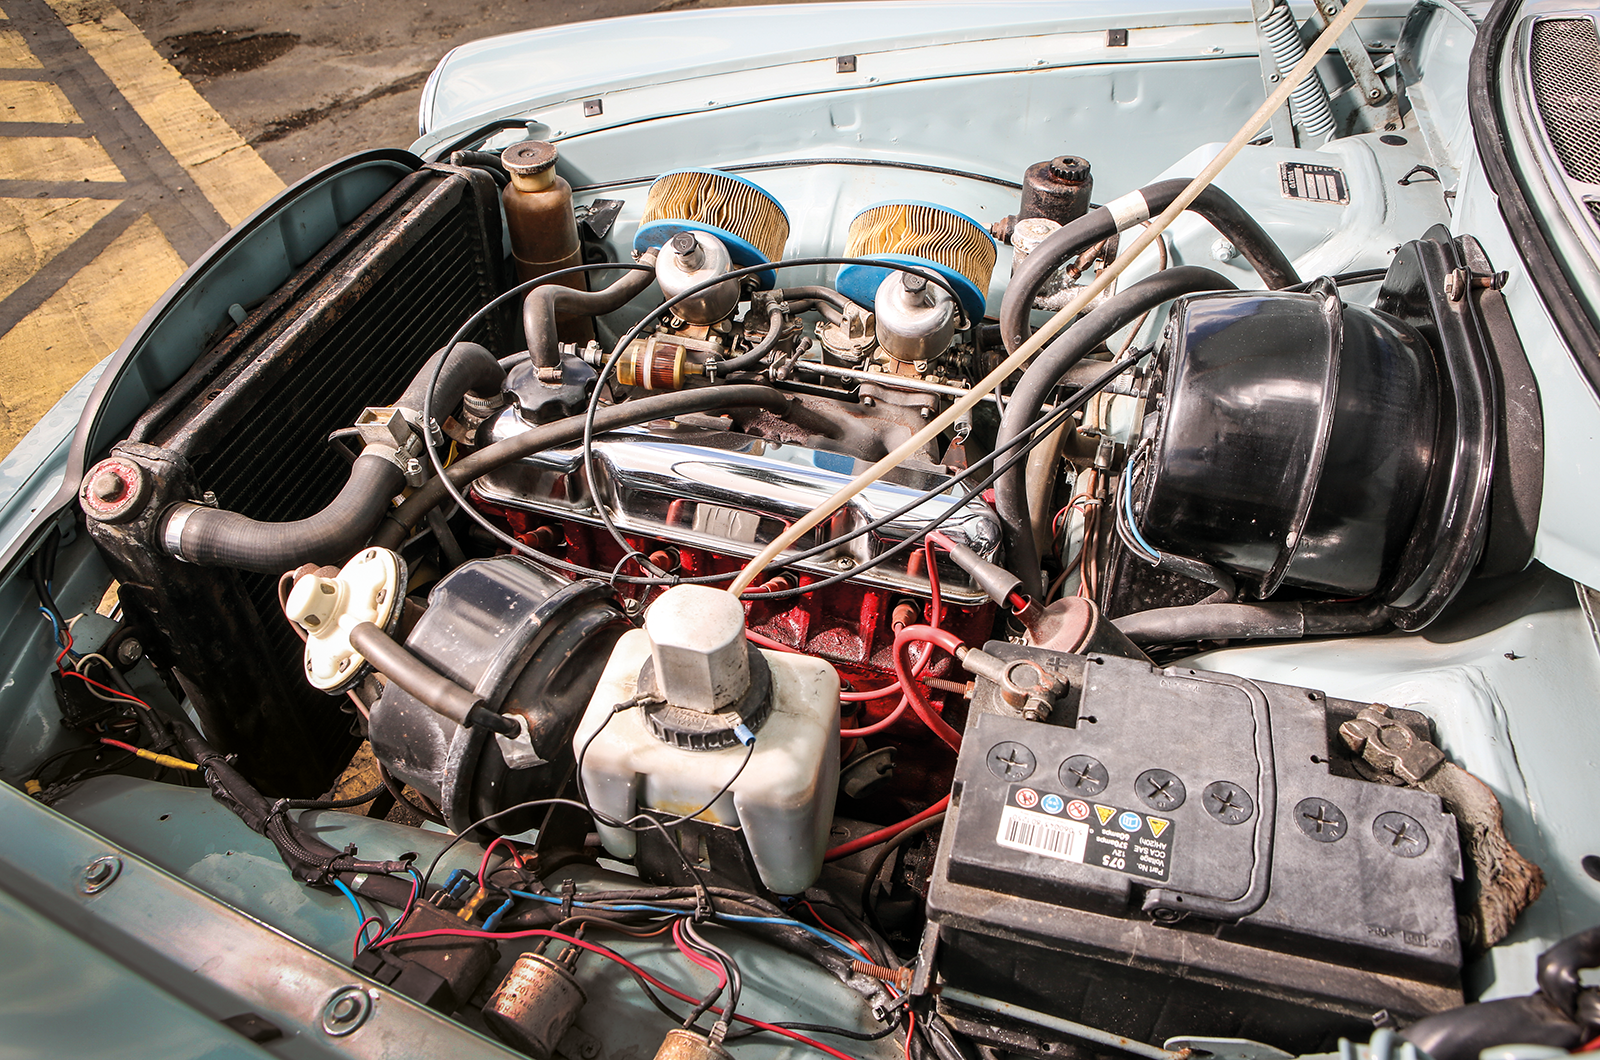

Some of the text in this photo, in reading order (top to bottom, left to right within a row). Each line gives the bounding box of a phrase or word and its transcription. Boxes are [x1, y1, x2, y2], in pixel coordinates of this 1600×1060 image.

[1101, 828, 1130, 841] 60amps
[1096, 836, 1166, 858] CCA SAE 570amps
[1102, 854, 1164, 875] Part No. 075
[1112, 849, 1165, 867] Voltage 12V
